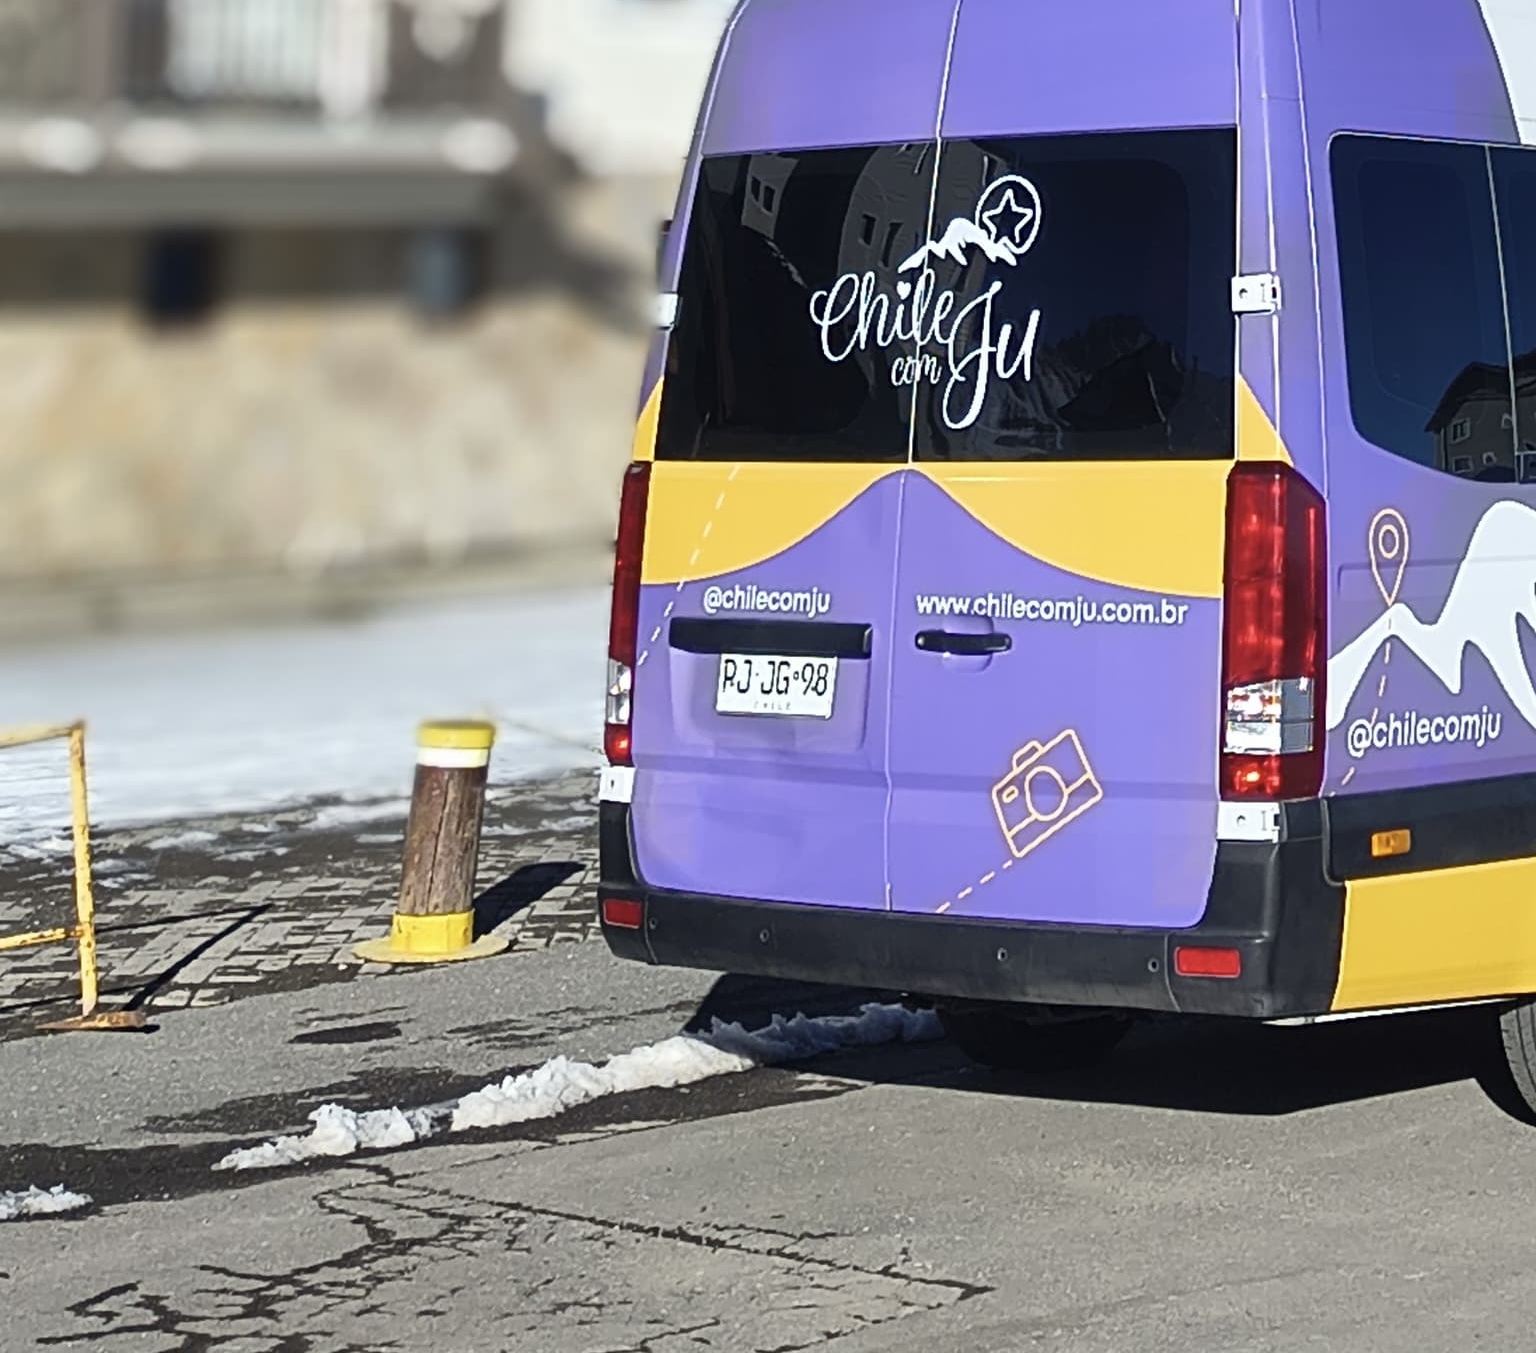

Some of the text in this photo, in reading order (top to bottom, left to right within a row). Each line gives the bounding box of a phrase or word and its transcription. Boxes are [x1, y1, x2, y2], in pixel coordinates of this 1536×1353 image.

[809, 268, 1041, 429] Chile Ju
[891, 353, 942, 386] com
[703, 586, 830, 618] @chilecomju
[917, 591, 1189, 626] www.chilecomju.com.br
[1348, 705, 1501, 758] @chilecomju
